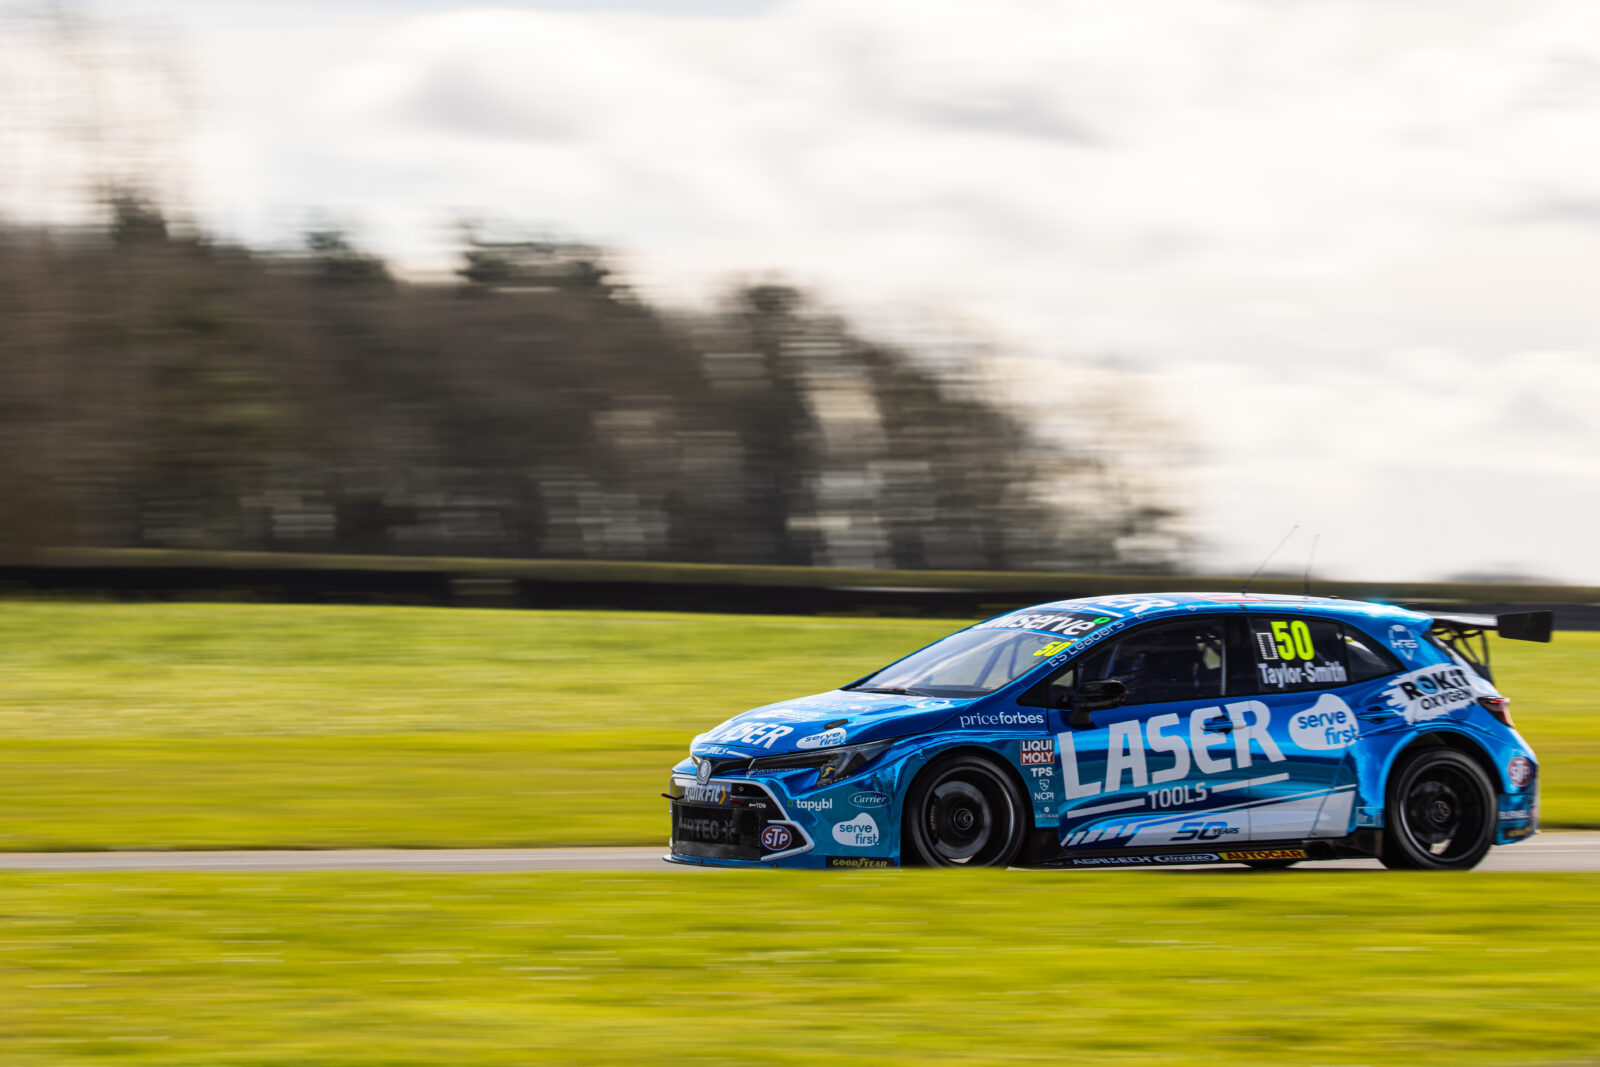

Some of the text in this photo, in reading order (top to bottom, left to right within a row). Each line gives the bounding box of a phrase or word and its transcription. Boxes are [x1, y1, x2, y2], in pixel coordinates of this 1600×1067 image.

[1270, 620, 1315, 660] 50
[1033, 641, 1072, 657] 50
[1257, 661, 1348, 688] Taylor-Smith
[1420, 689, 1473, 710] OXYGEN
[1297, 711, 1347, 729] serve
[804, 731, 841, 742] serve
[1022, 740, 1053, 752] LIQUI
[1057, 700, 1287, 800] LASER
[1022, 752, 1053, 763] MOLY
[853, 794, 887, 804] Carrier
[1034, 792, 1054, 800] NCPI
[1148, 782, 1208, 809] TOOLS
[796, 798, 833, 812] tapybl
[839, 824, 873, 833] serve
[1168, 821, 1240, 842] 50 YEARS
[764, 828, 790, 847] STP
[832, 858, 888, 868] GOODYEAR
[1226, 850, 1303, 861] AUTOCAR
